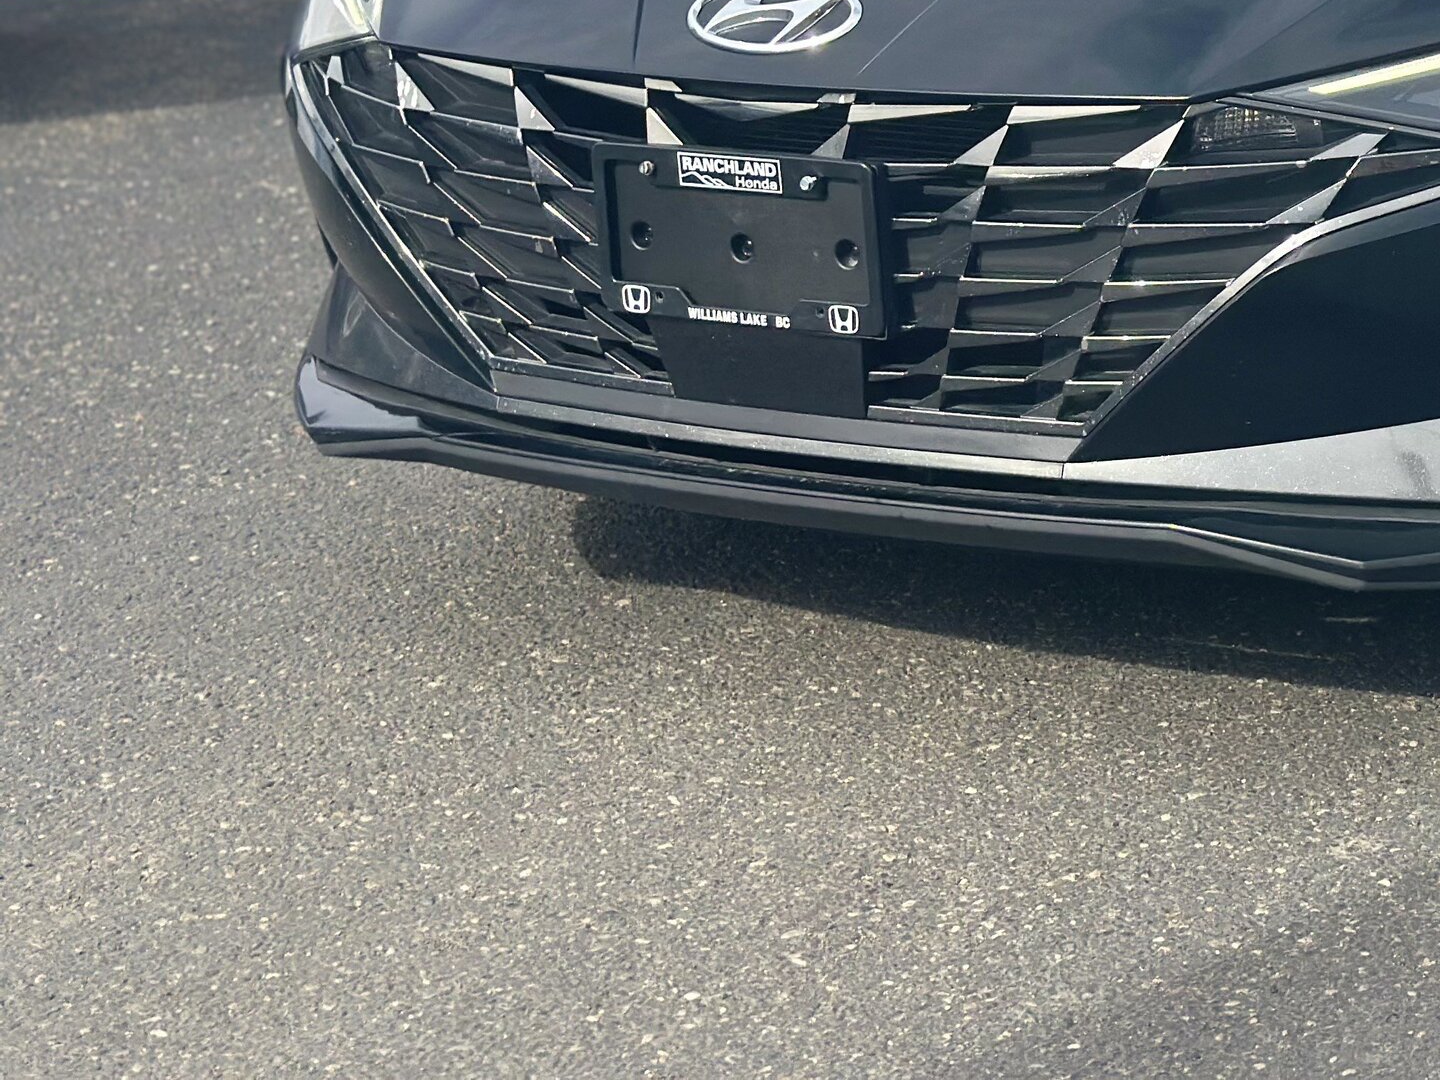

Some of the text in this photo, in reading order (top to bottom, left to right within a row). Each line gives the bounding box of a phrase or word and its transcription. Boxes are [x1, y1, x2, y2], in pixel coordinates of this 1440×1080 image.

[681, 156, 777, 177] RANCHLAND
[735, 175, 778, 191] Honda
[687, 306, 791, 329] WILLIAMS LAKE BC
